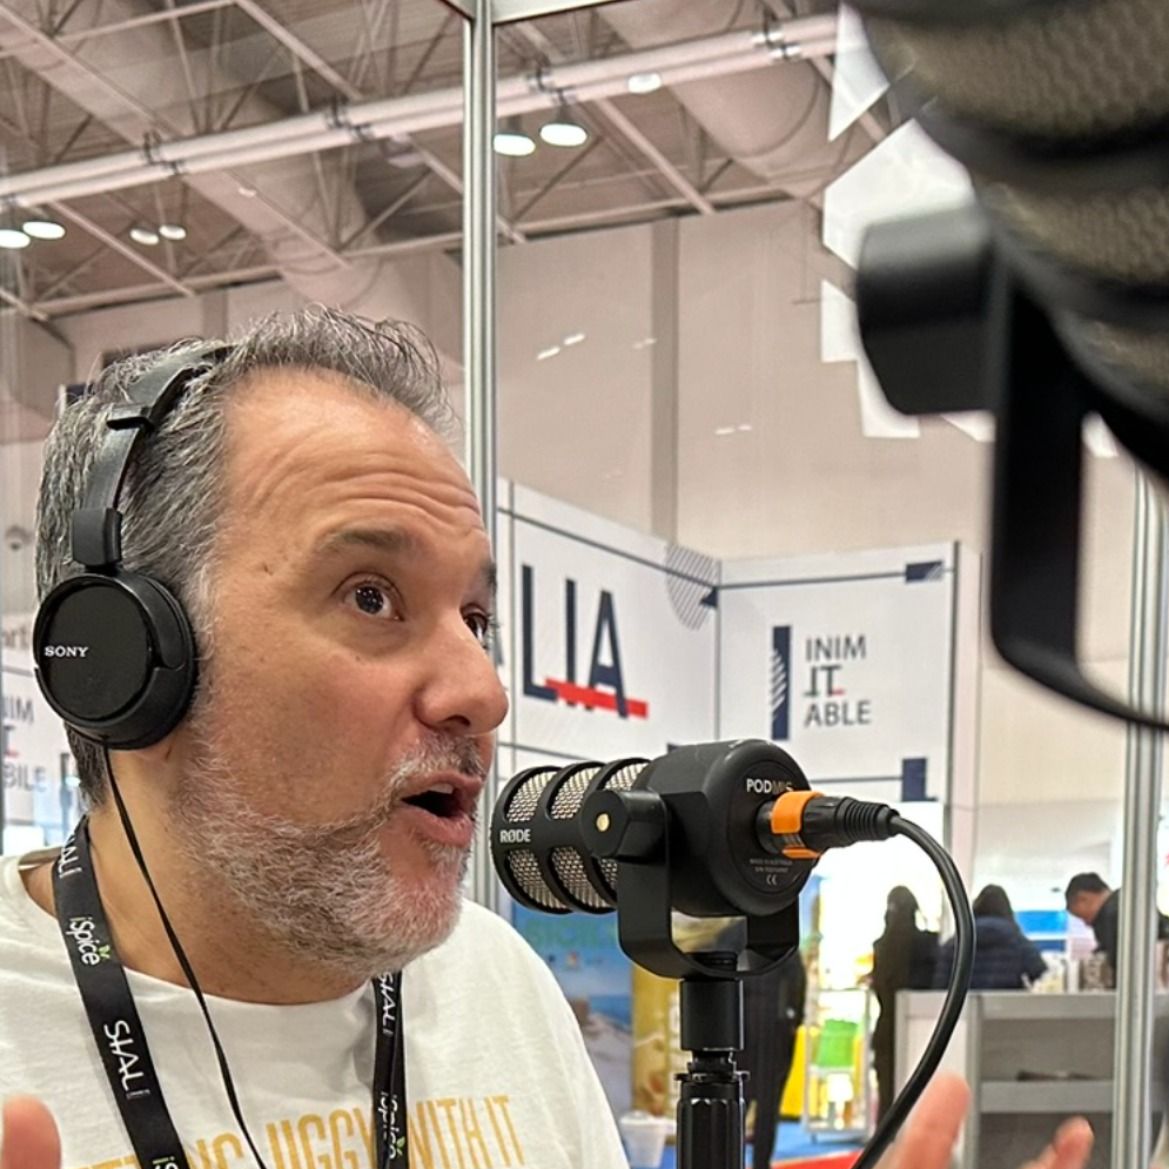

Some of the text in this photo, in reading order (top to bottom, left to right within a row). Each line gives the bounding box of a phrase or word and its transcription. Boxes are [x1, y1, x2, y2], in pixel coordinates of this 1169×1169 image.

[44, 646, 88, 657] SONY
[805, 635, 867, 662] INIM
[804, 665, 845, 696] IT
[803, 701, 872, 728] ABLE
[500, 828, 531, 844] RØDE
[65, 916, 101, 966] iSpice
[483, 1094, 526, 1168] IT
